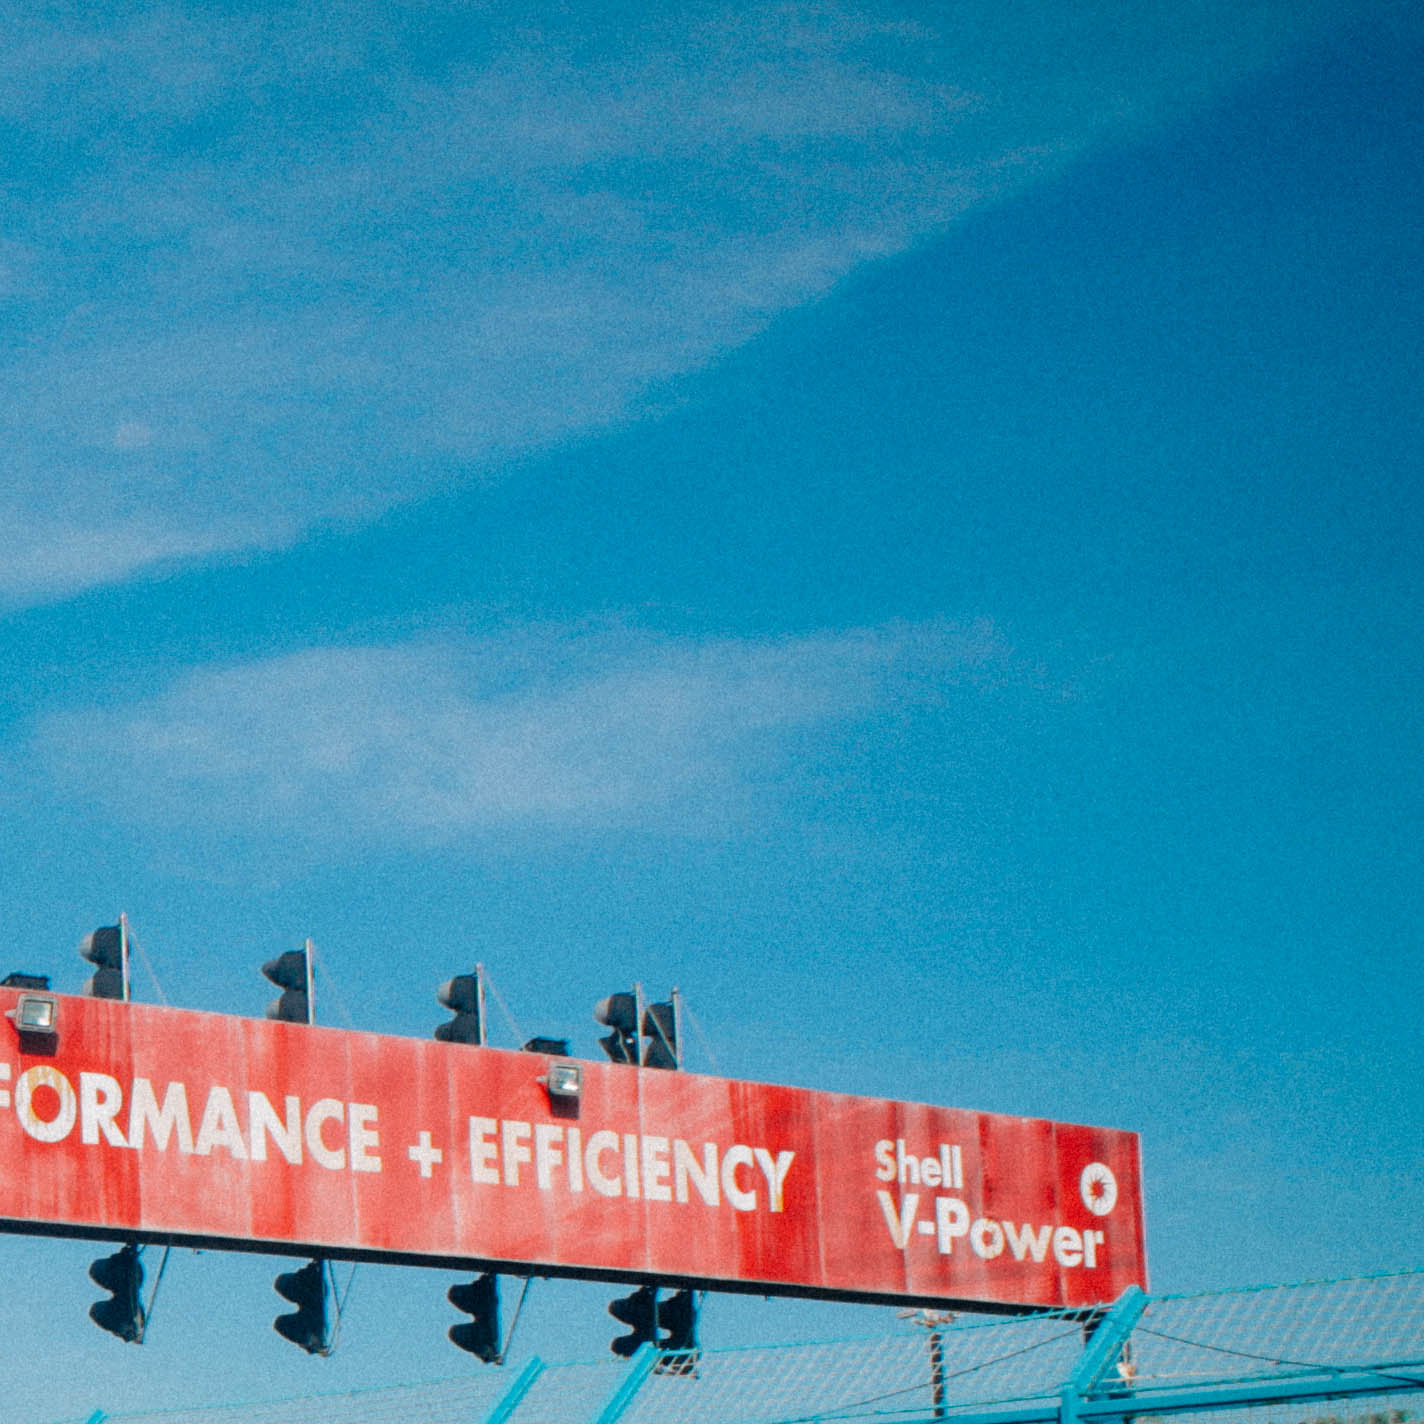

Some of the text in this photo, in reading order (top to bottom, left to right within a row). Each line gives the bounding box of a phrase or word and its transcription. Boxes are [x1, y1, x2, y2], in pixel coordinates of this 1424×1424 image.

[469, 1116, 795, 1212] EFFICIENCY
[874, 1138, 963, 1189] Shell
[876, 1189, 1105, 1268] V-Power
